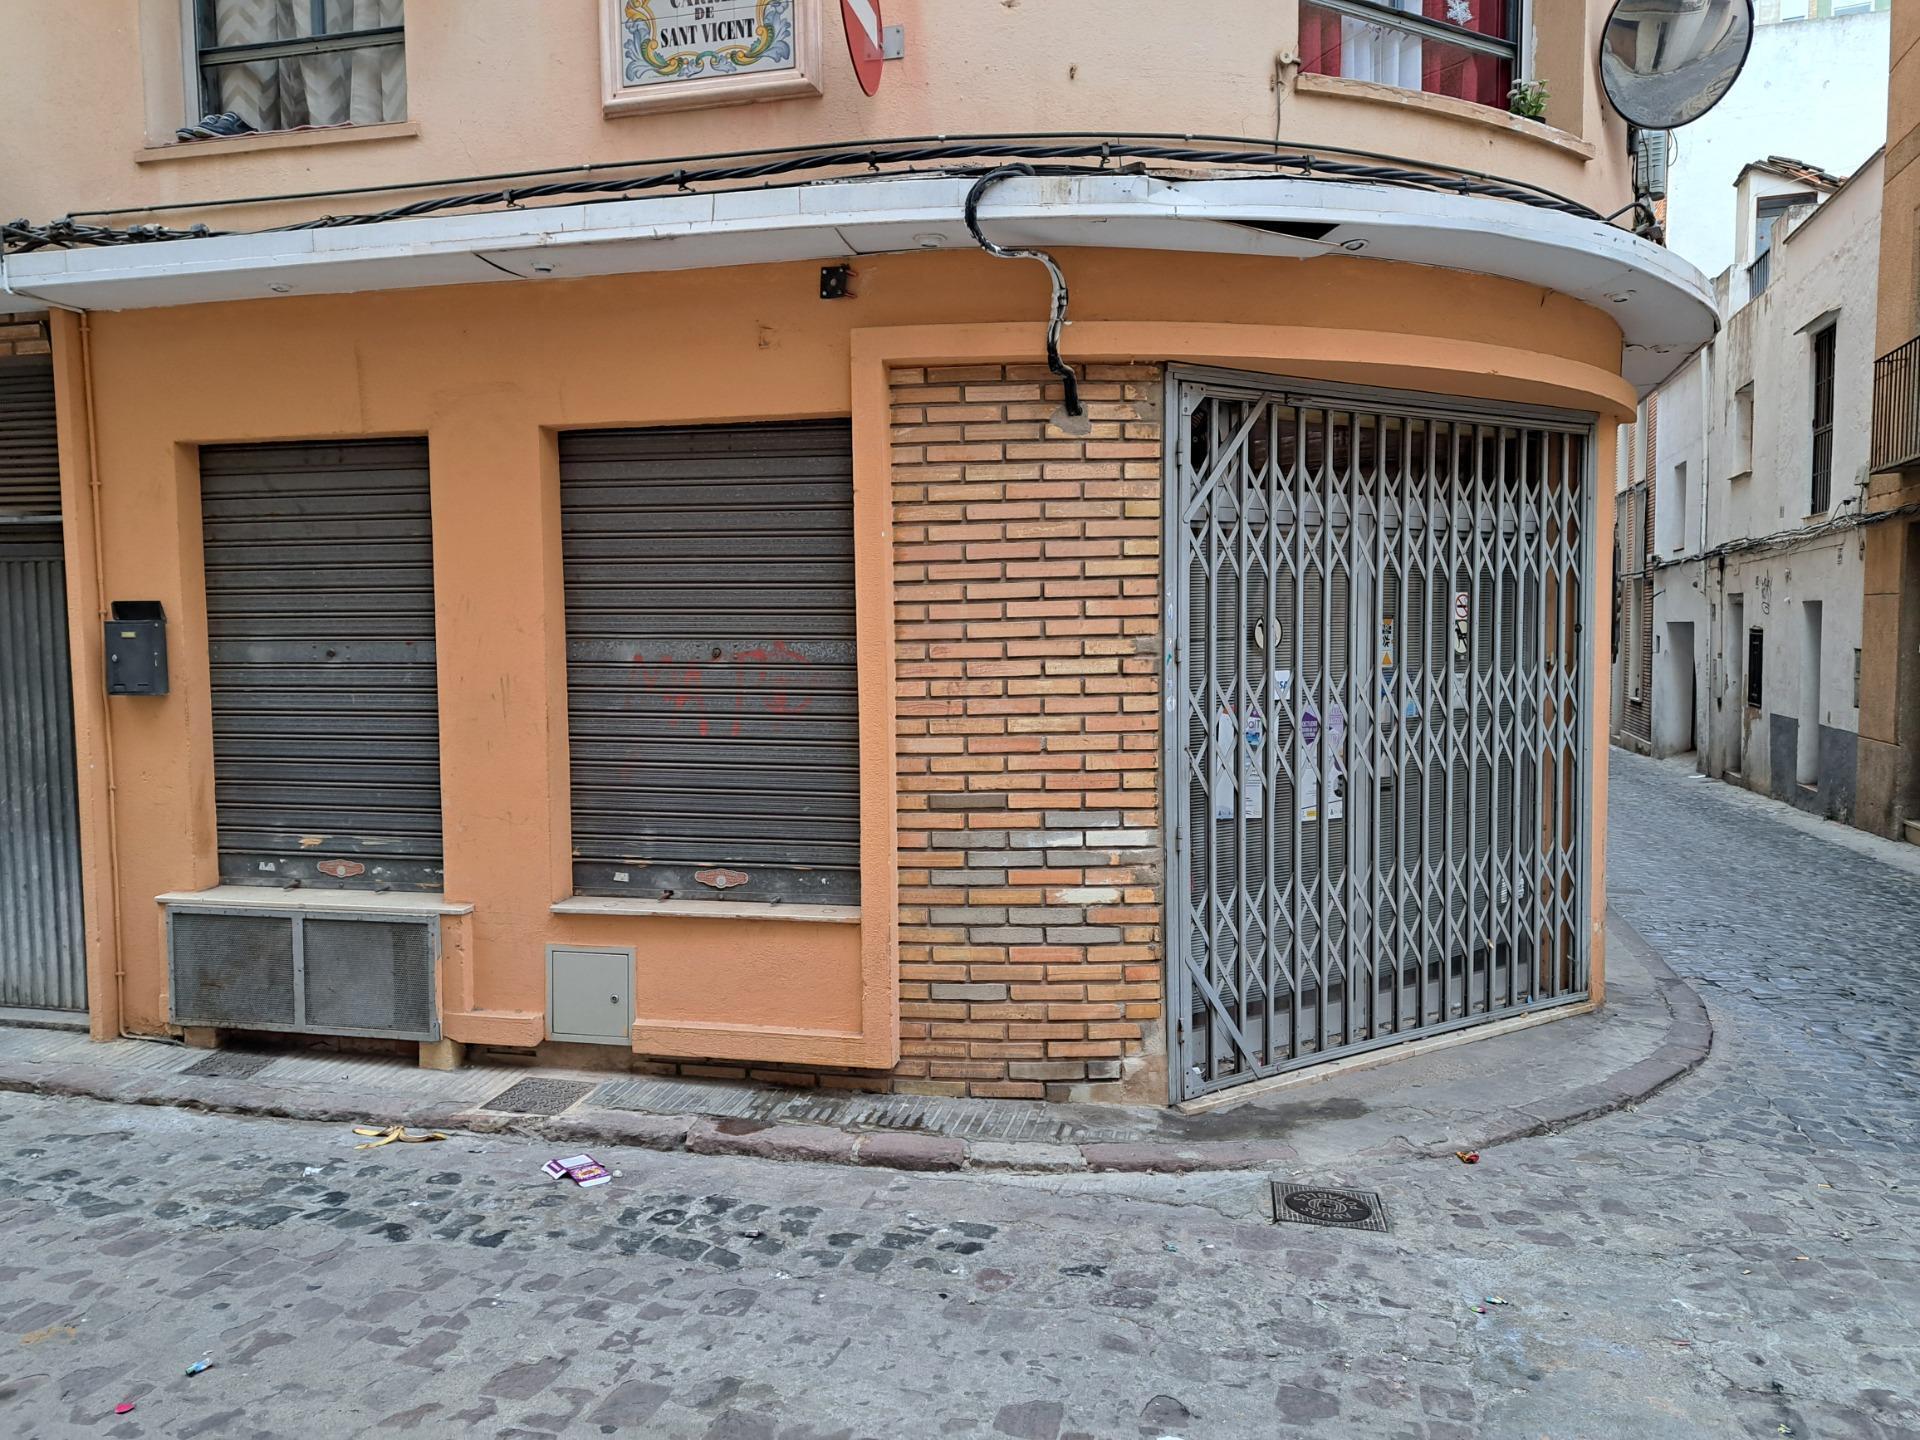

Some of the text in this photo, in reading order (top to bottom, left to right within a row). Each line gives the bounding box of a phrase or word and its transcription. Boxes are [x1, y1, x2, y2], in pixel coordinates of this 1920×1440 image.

[695, 6, 715, 20] DE
[660, 18, 755, 48] SANT VICENT
[1293, 1192, 1365, 1211] POTABLES
